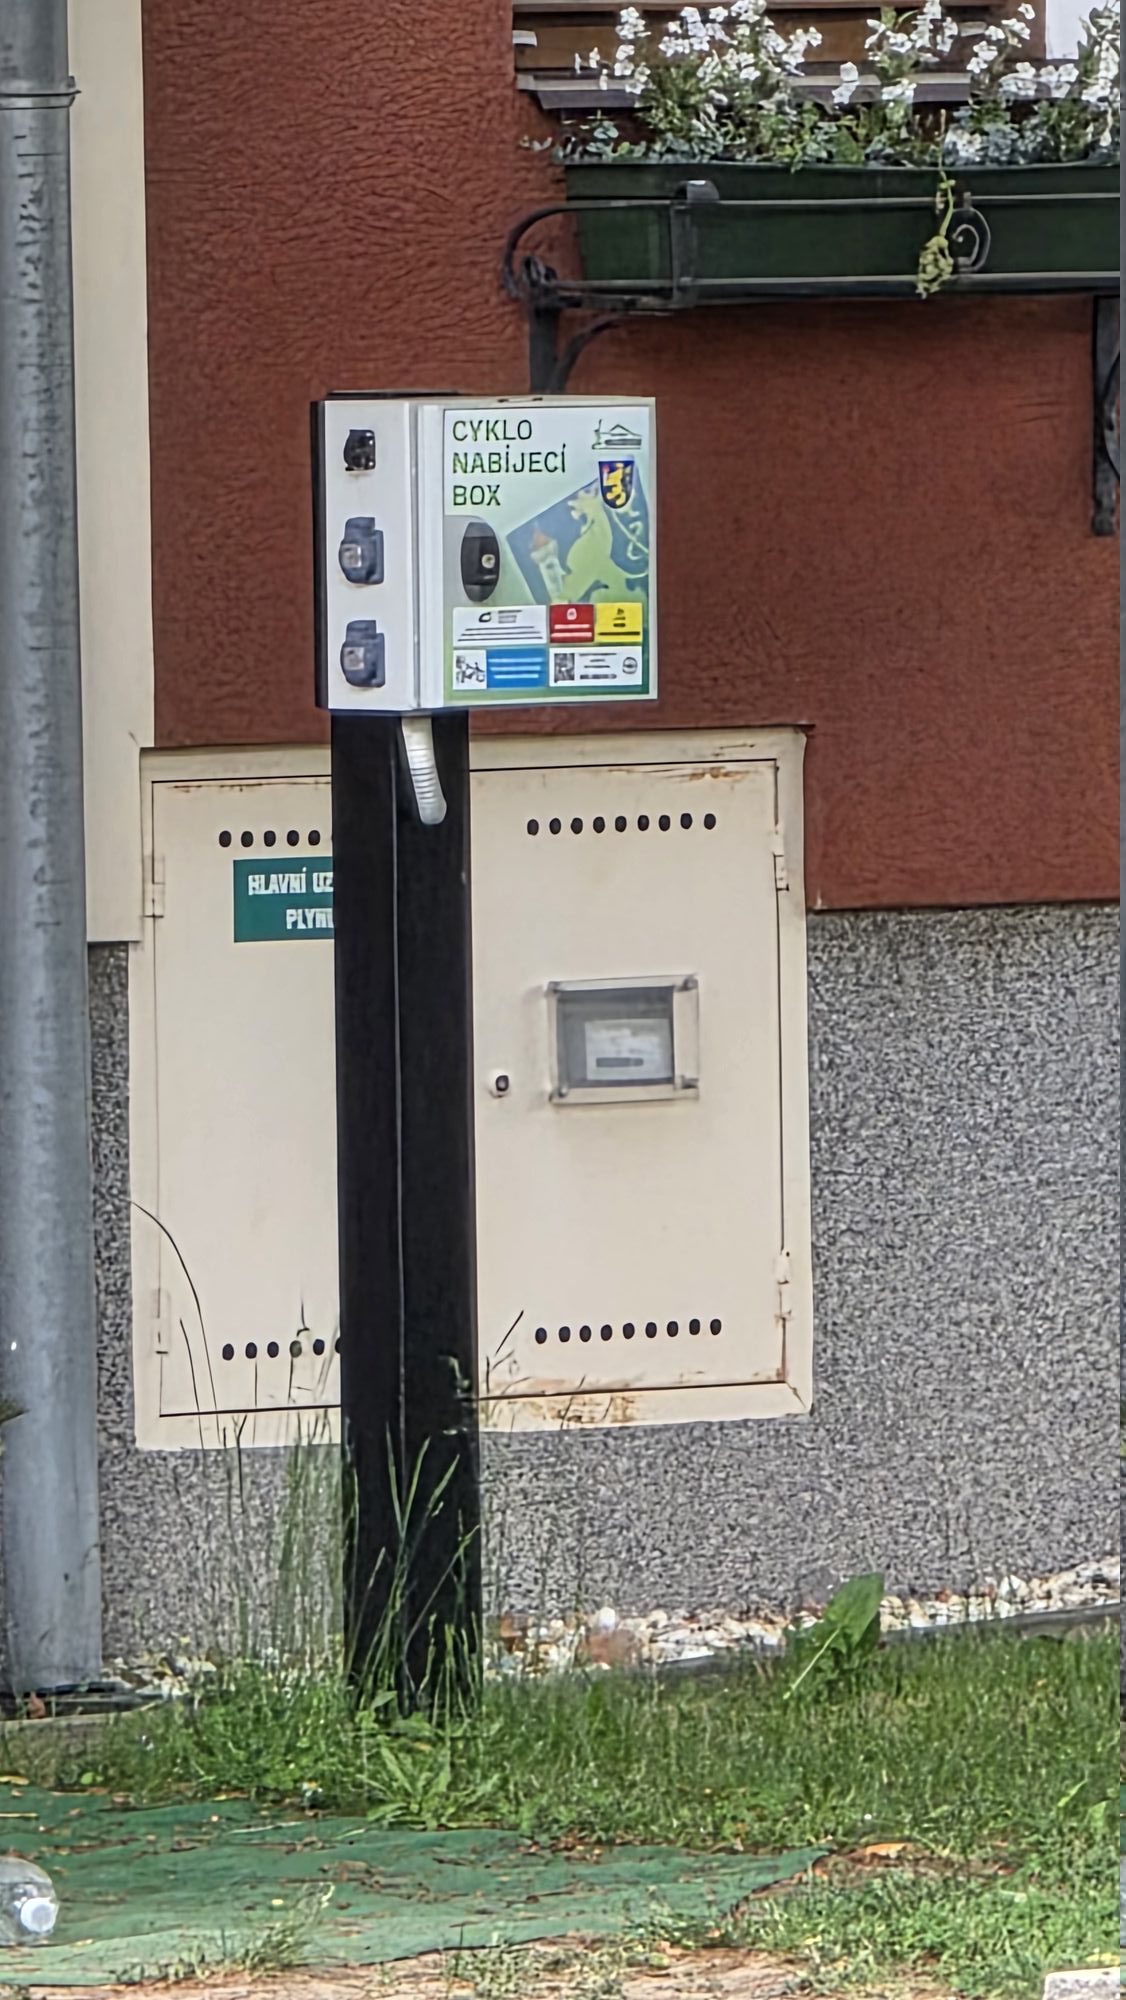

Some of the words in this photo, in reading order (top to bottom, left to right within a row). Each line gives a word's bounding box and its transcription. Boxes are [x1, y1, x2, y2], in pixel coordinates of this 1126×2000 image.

[452, 419, 533, 442] CYKLO
[452, 443, 566, 474] NABÍJECÍ
[452, 484, 502, 506] BOX
[247, 866, 307, 896] HLAVNÍ
